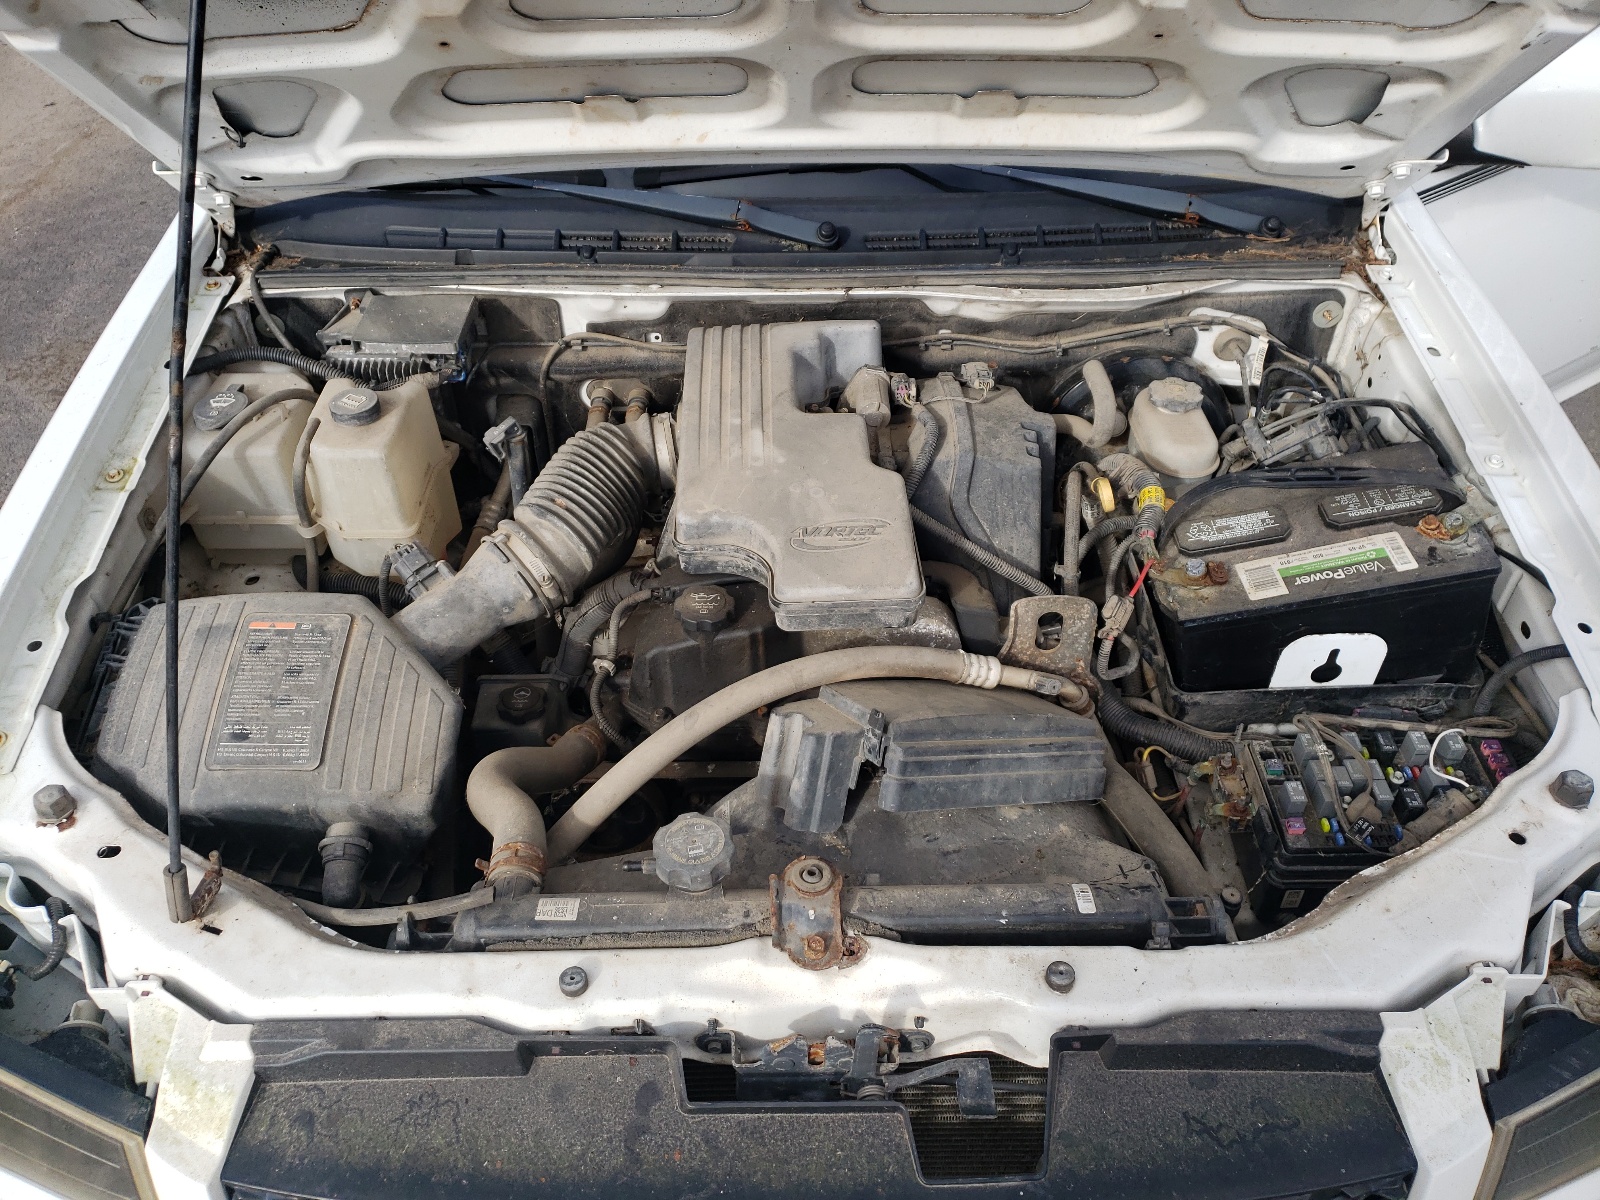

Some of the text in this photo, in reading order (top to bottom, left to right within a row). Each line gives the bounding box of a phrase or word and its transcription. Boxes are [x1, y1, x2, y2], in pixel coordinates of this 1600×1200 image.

[1384, 501, 1417, 511] DANGER
[1348, 508, 1378, 517] POISON
[791, 525, 887, 537] VORTEC
[1294, 560, 1386, 586] ValuePower
